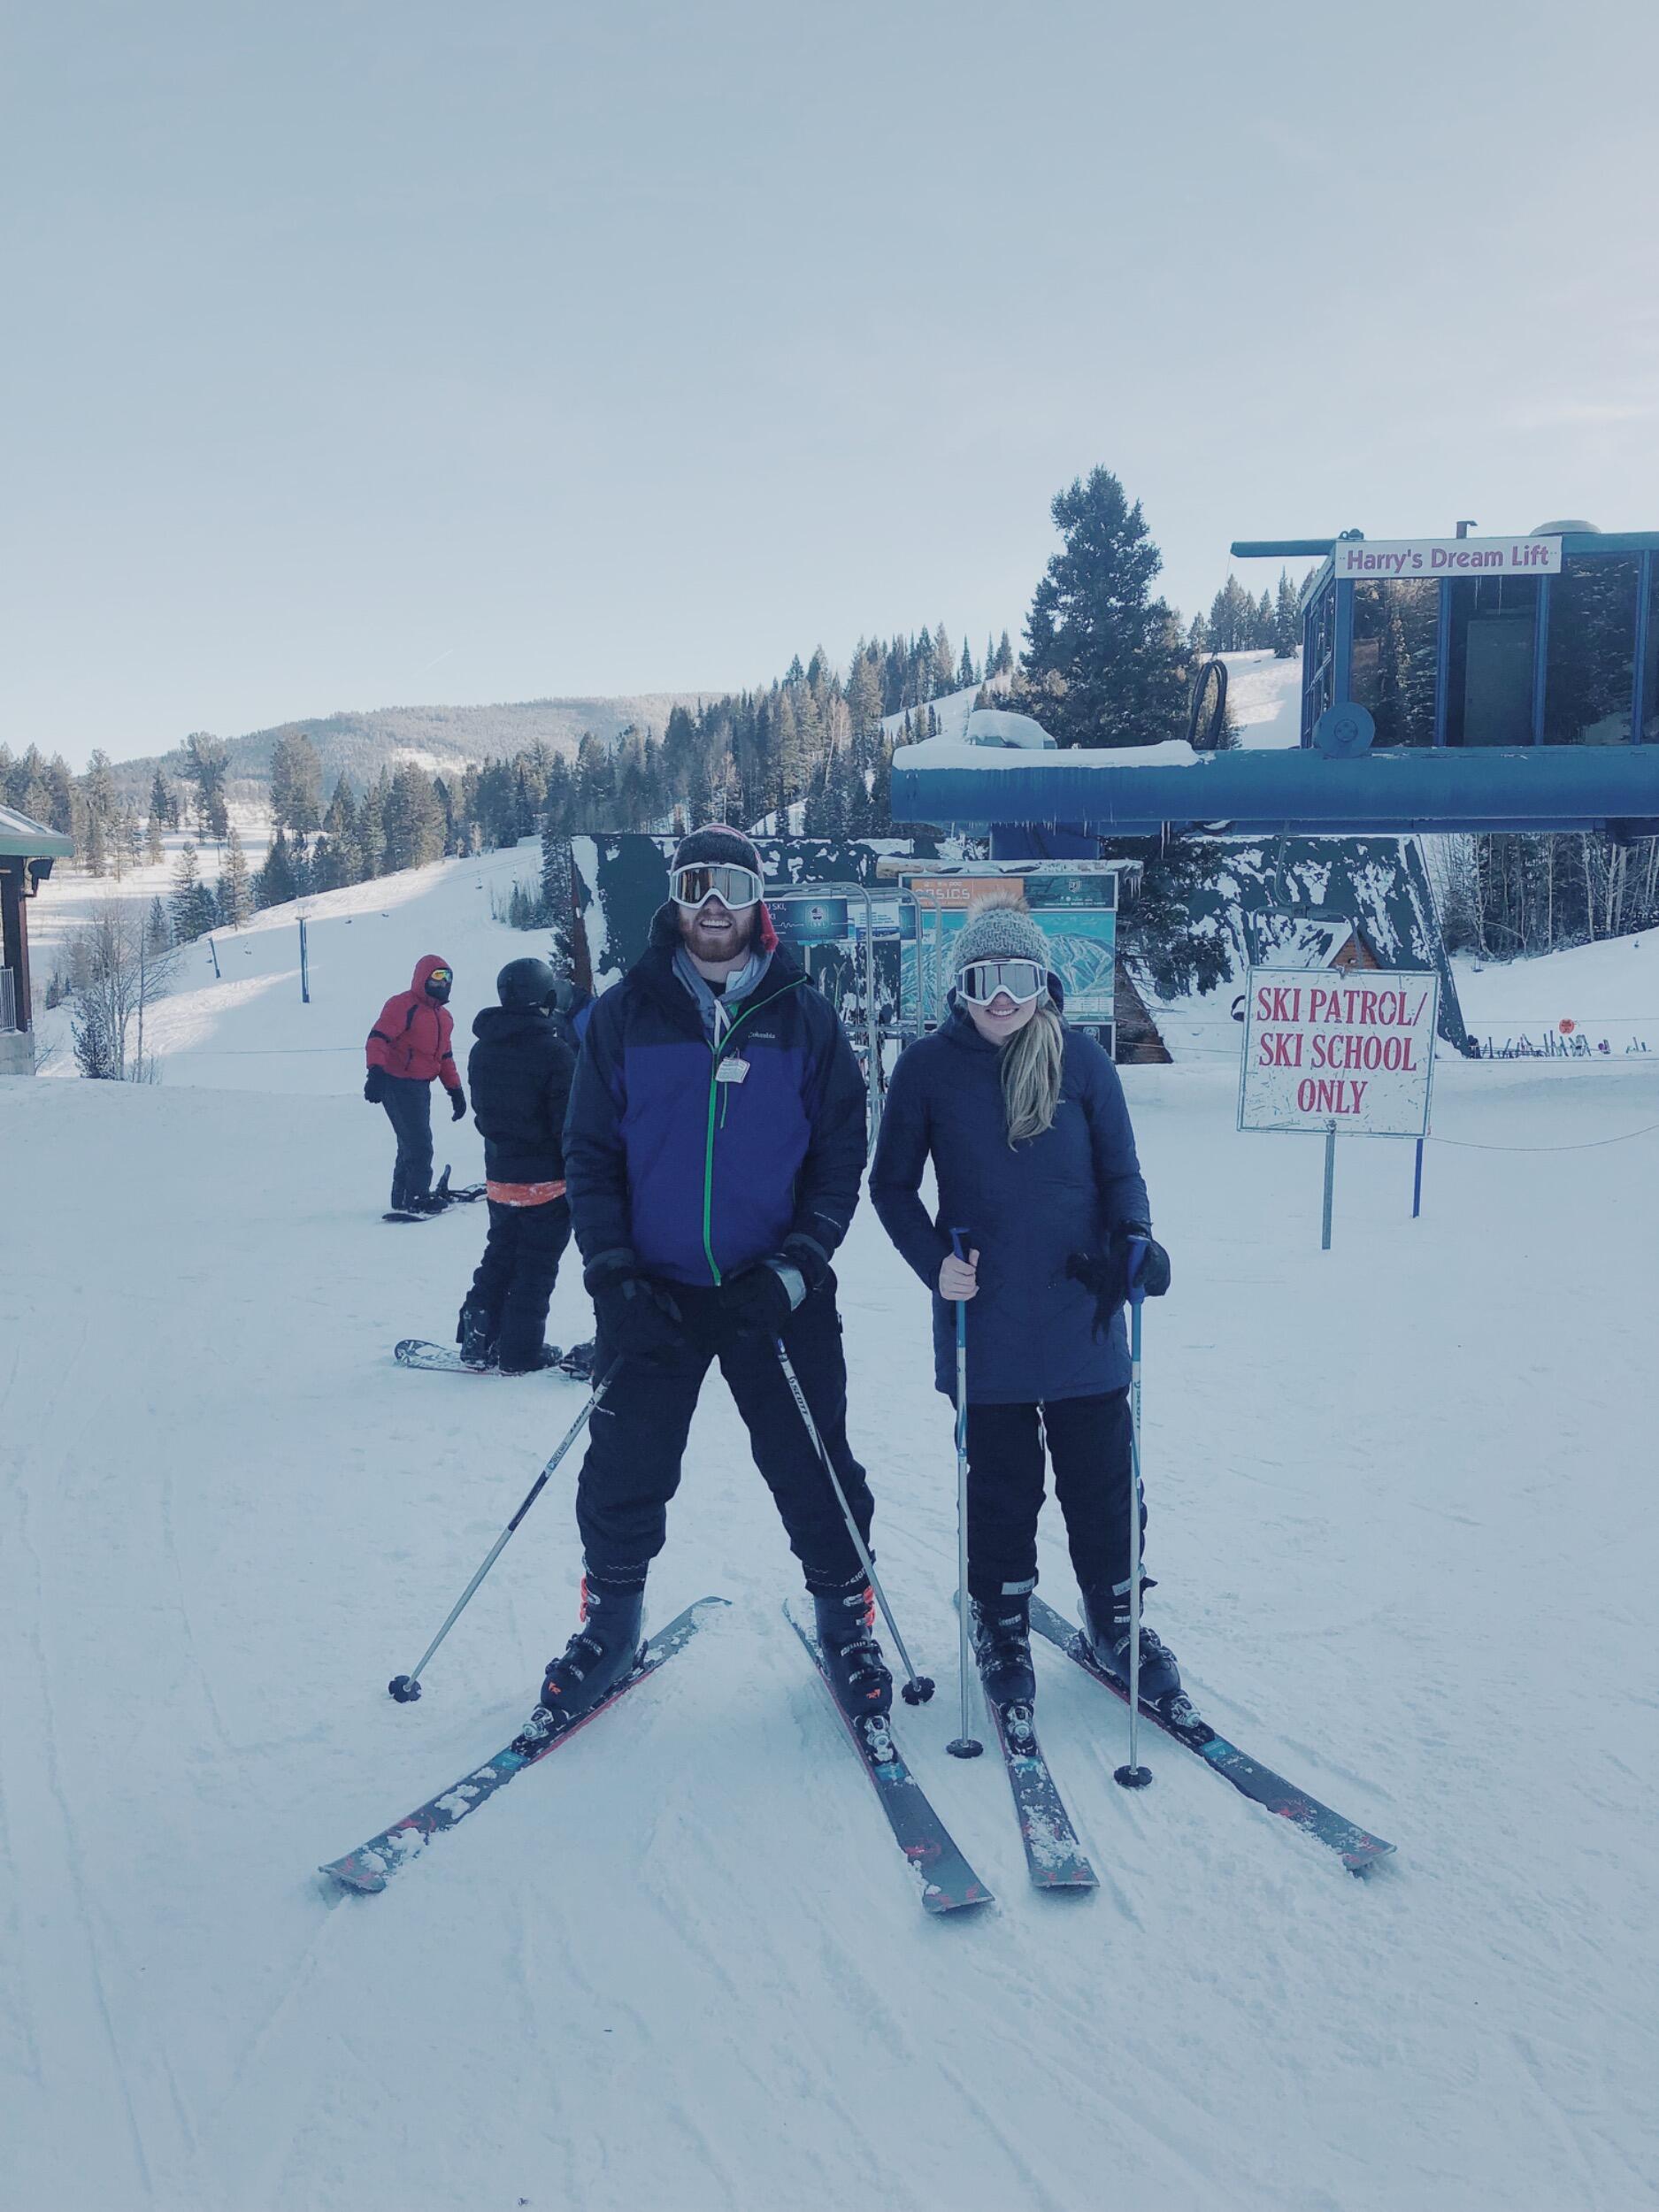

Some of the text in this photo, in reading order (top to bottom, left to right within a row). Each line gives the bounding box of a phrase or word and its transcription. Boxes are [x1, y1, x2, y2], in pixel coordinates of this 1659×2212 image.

[1347, 544, 1548, 573] Harry's Dream Lift
[1256, 987, 1428, 1026] SKI PATROL/
[1259, 1033, 1417, 1071] SKI SCHOOL
[1297, 1078, 1368, 1114] ONLY
